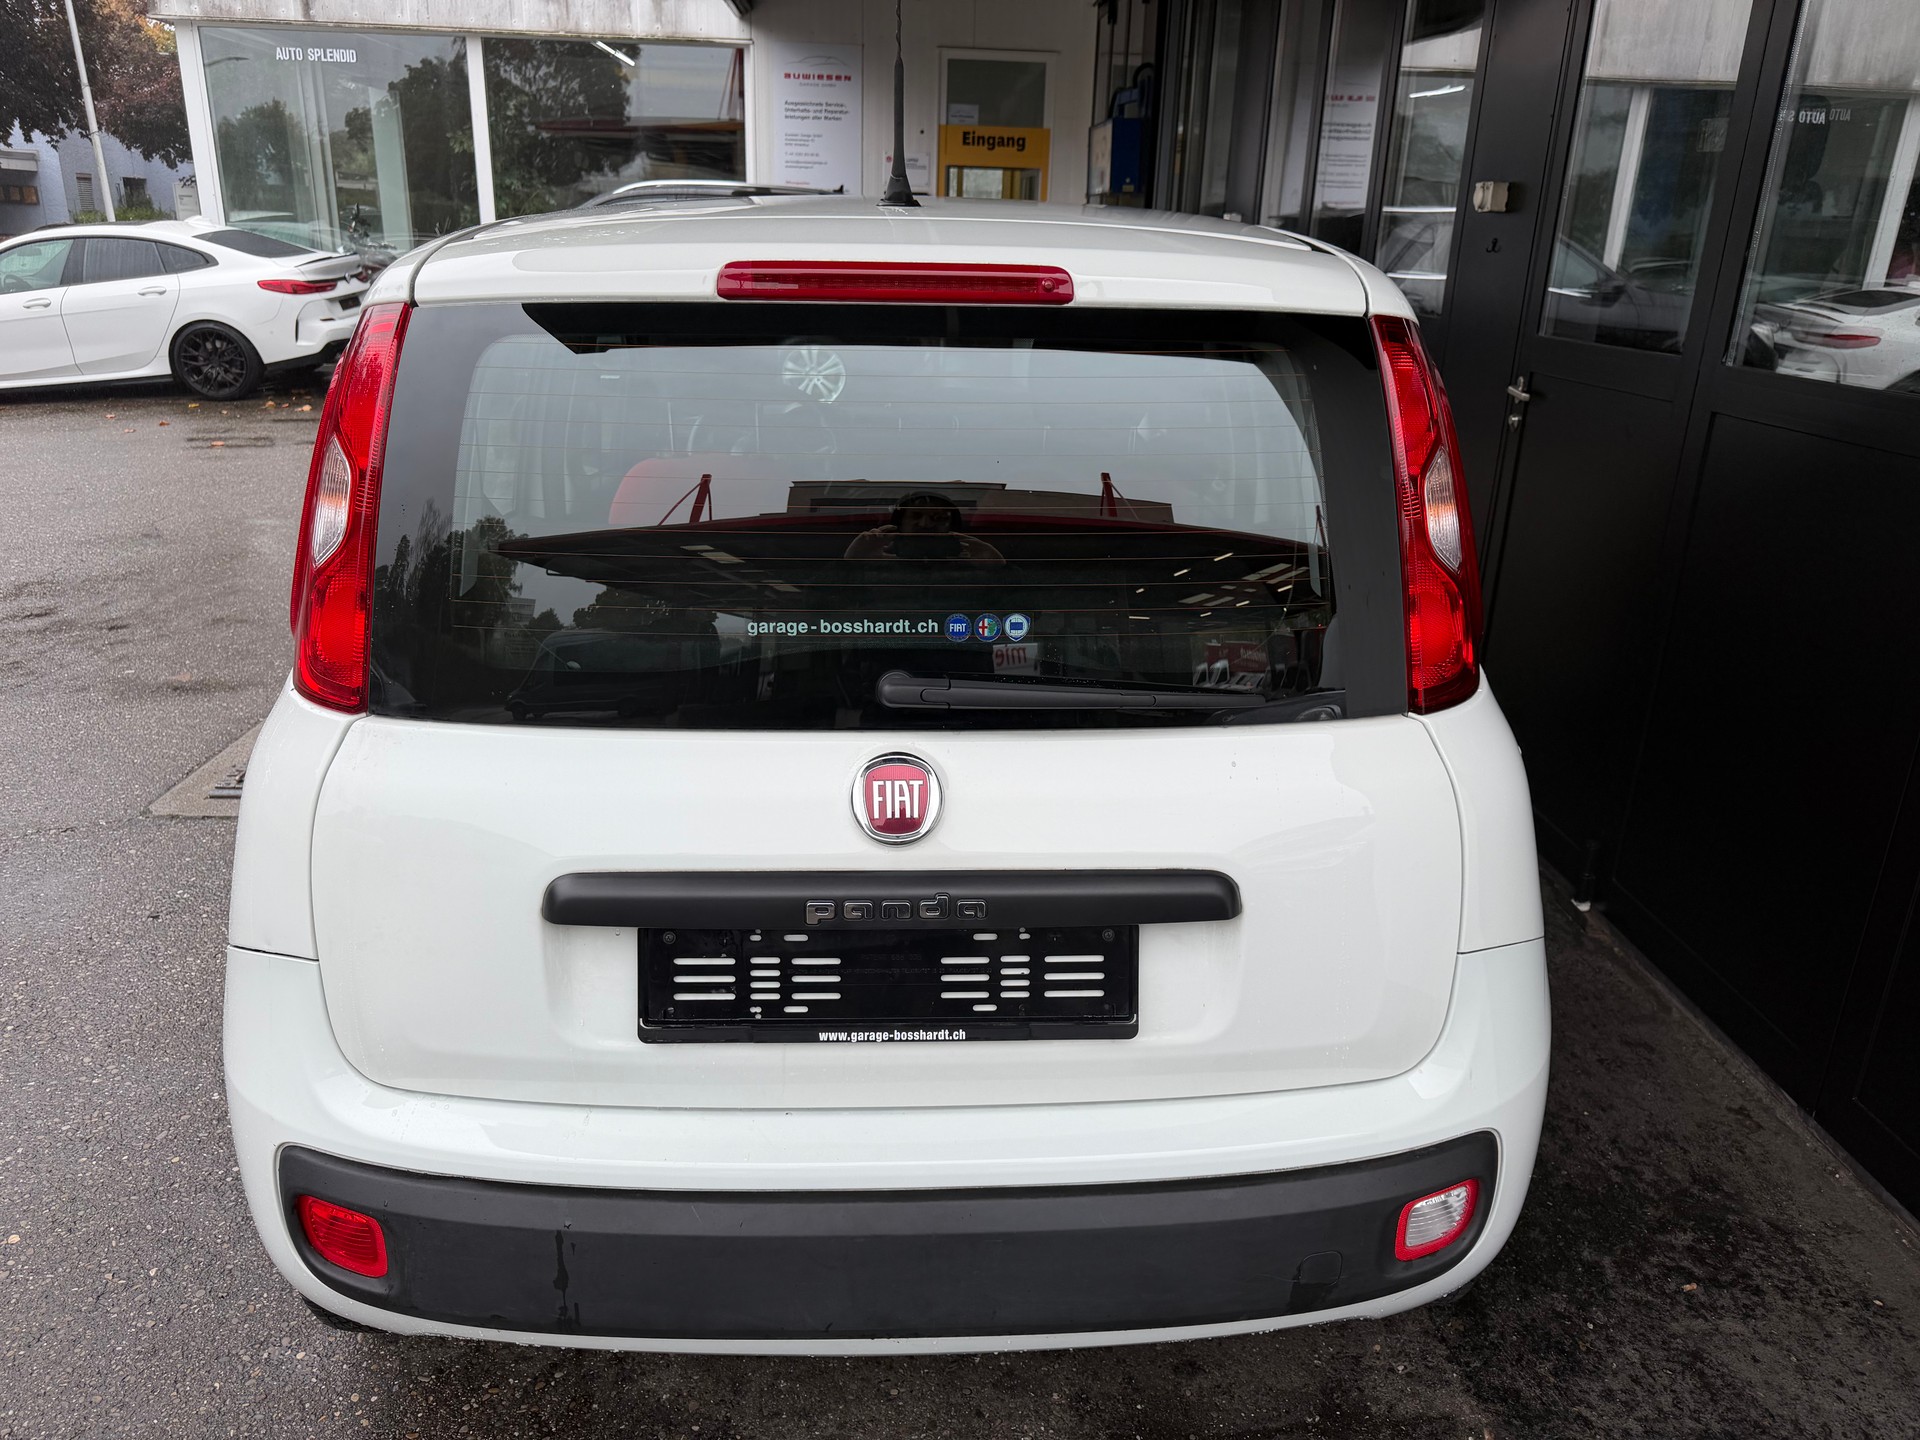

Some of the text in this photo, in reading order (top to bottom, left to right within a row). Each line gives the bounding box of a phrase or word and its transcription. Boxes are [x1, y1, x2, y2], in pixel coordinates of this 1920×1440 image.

[276, 46, 357, 63] AUTO SPLENDID
[962, 131, 1026, 152] Eingang
[747, 618, 939, 636] garage-bosshardt.ch
[949, 623, 967, 633] FIAT
[872, 780, 924, 819] FIAT
[805, 892, 988, 926] panda
[818, 1029, 966, 1042] www.garage-bosshardt.ch
